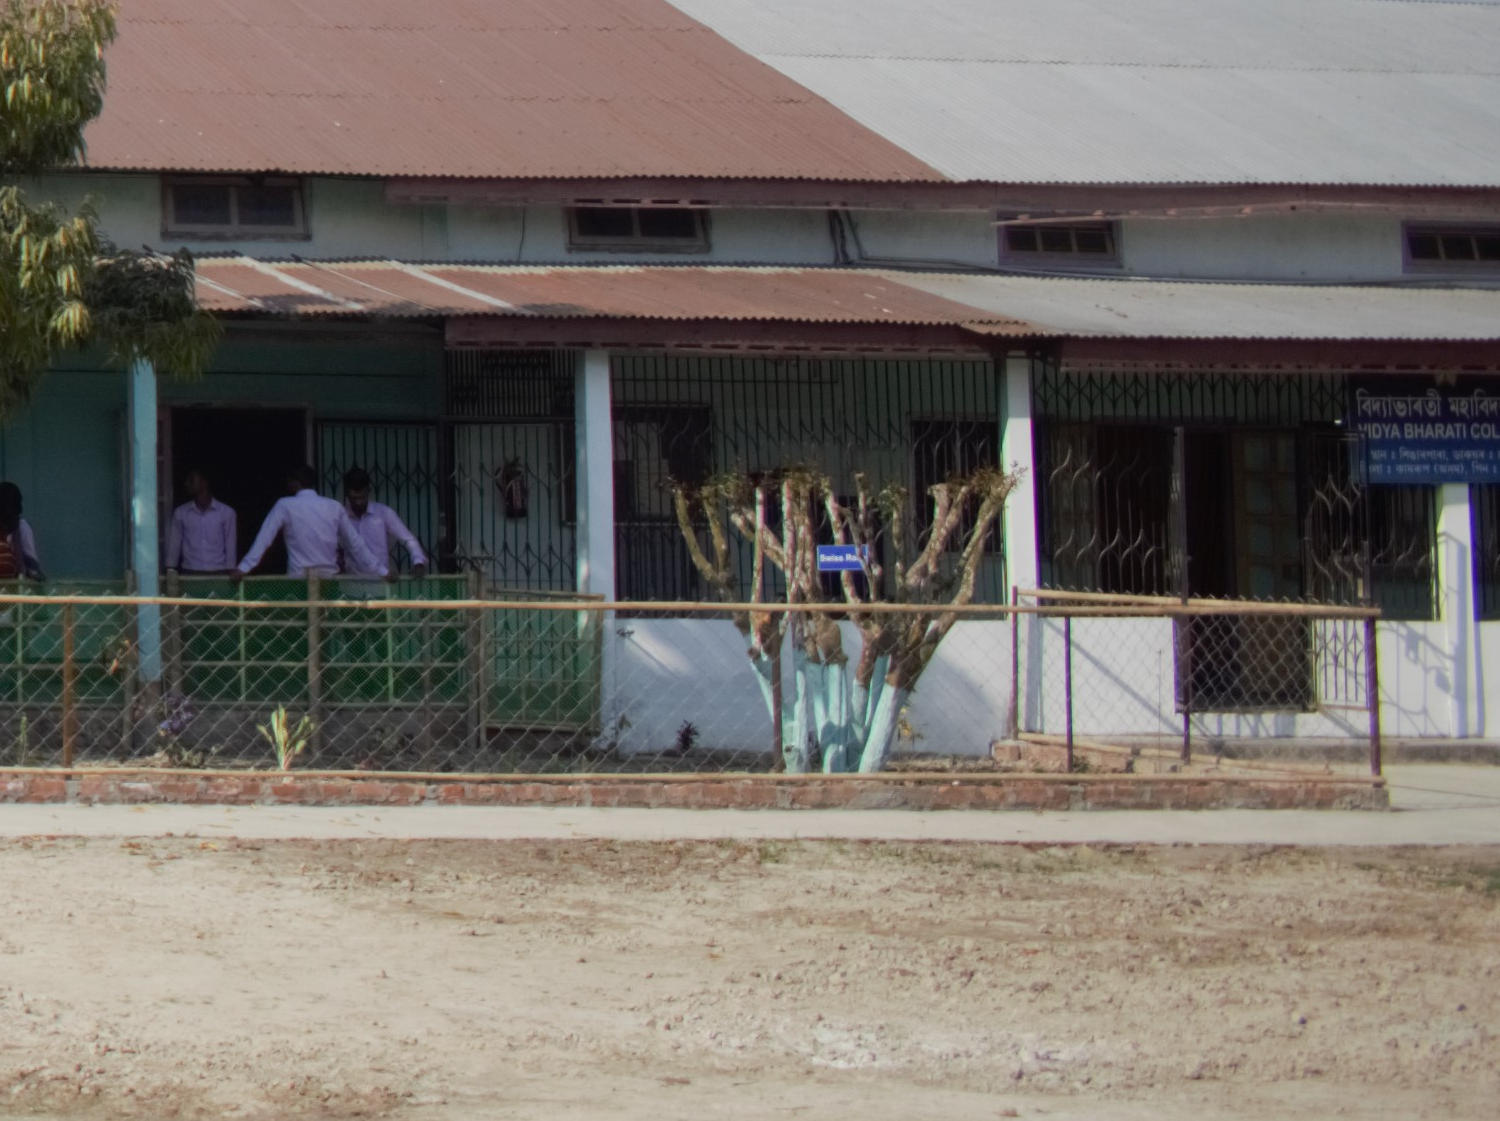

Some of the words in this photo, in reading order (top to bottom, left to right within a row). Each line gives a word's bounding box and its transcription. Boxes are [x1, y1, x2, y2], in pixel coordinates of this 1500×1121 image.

[1358, 423, 1400, 439] VIDYA
[1404, 423, 1467, 439] BHARATI
[1470, 423, 1500, 439] COL
